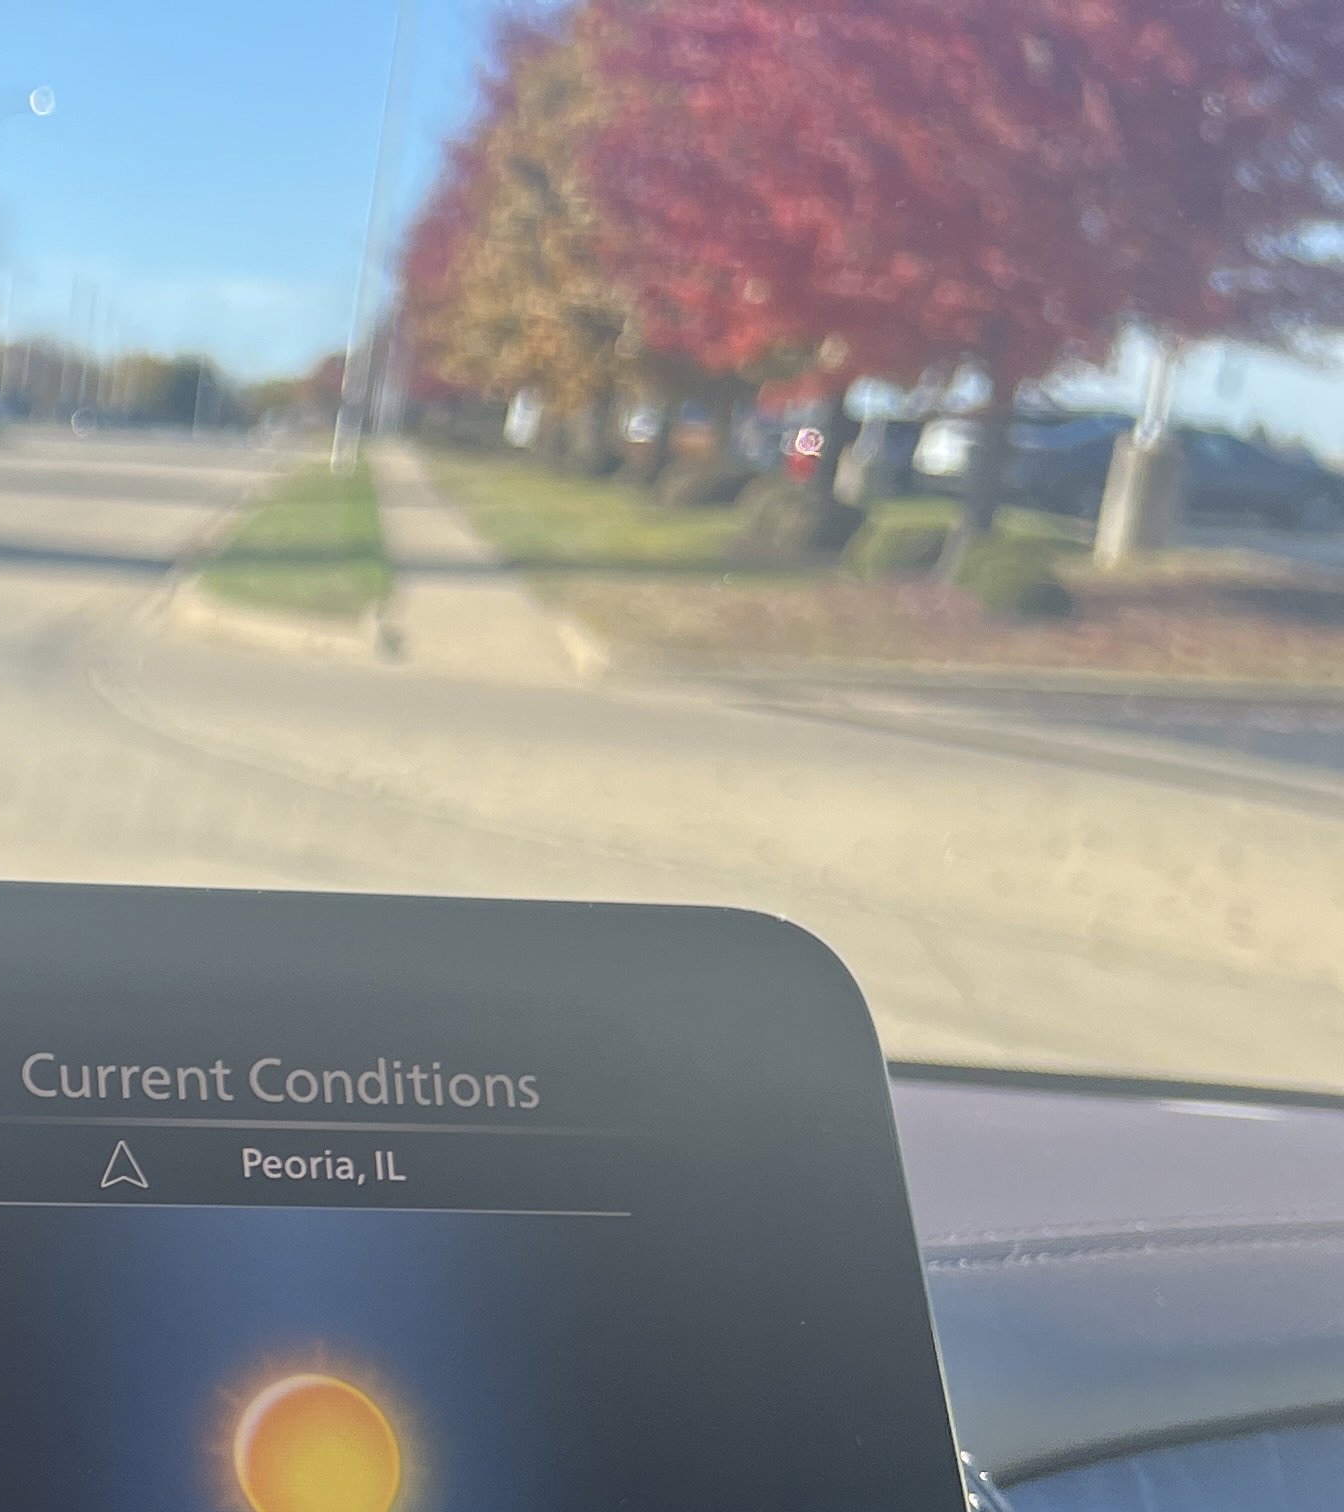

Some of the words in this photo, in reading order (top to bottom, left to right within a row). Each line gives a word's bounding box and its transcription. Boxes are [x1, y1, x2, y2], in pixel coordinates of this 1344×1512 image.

[20, 1051, 235, 1102] Current
[249, 1056, 541, 1109] Conditions
[241, 1147, 366, 1186] Peoria,
[374, 1150, 407, 1182] IL
